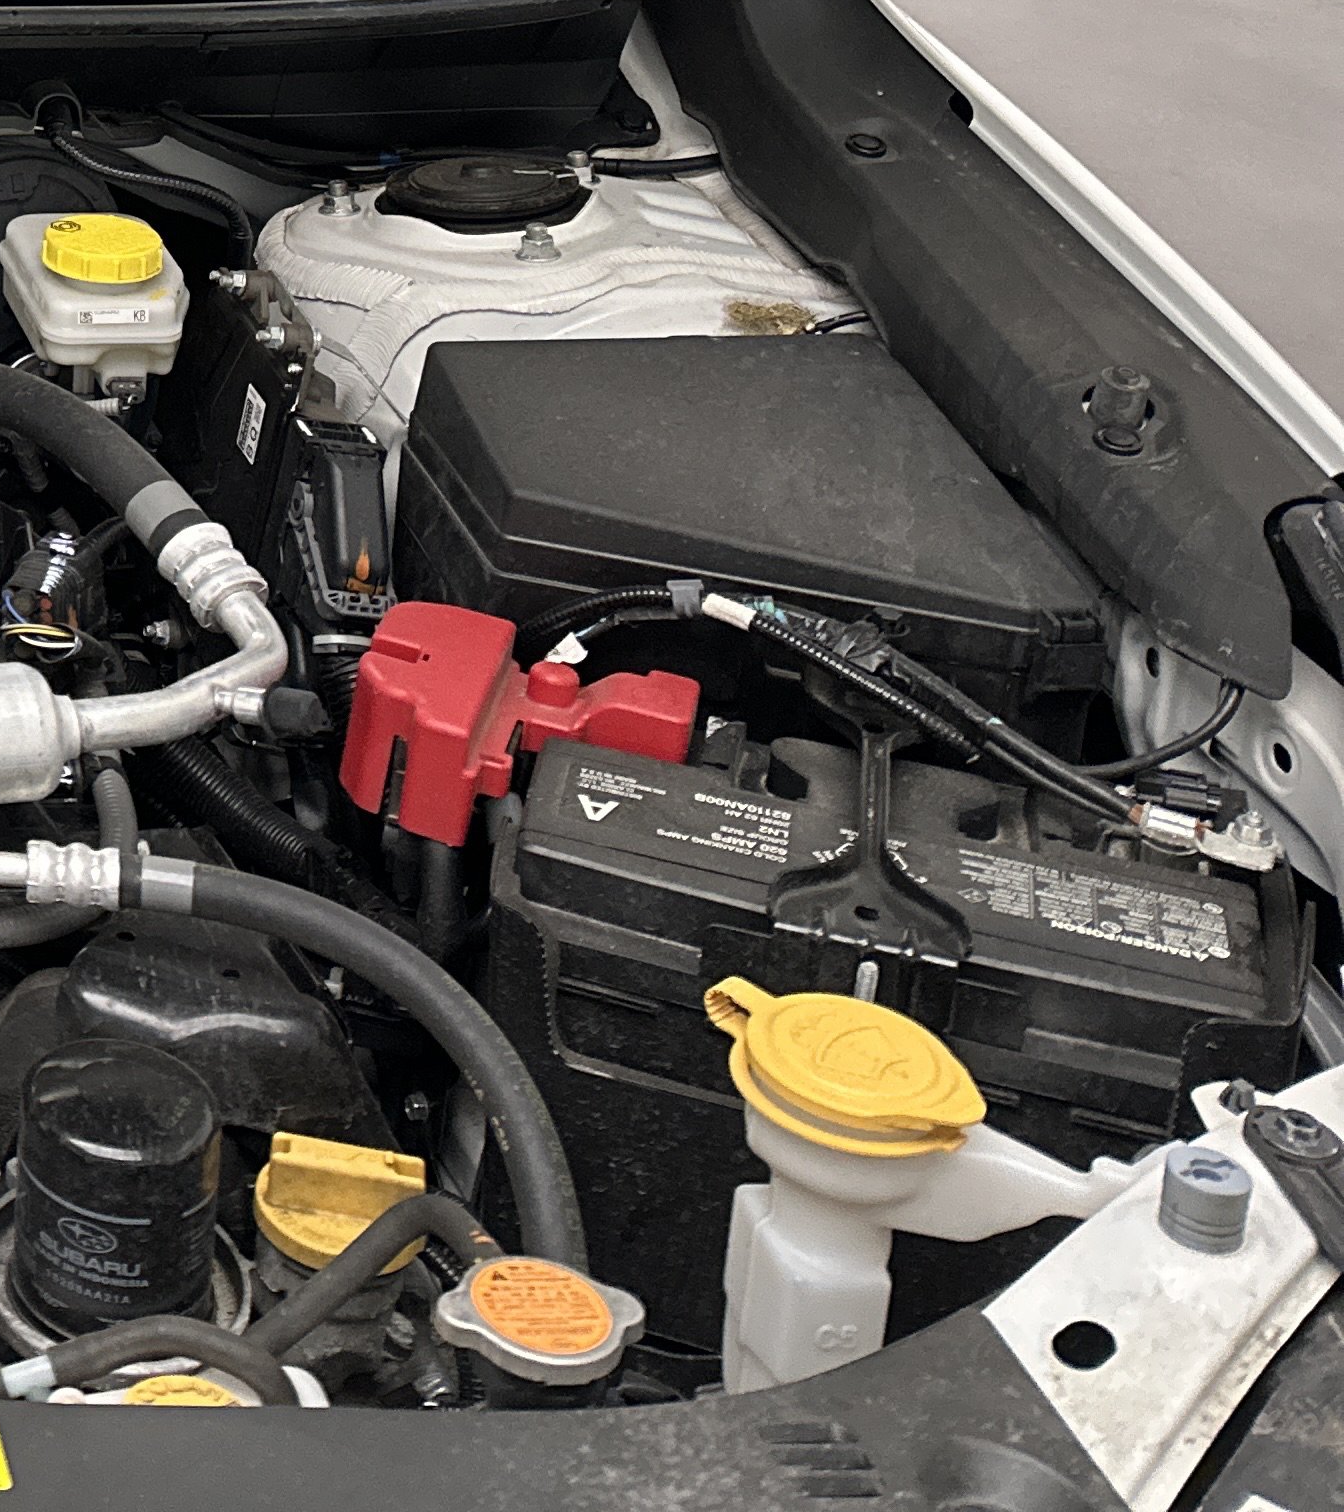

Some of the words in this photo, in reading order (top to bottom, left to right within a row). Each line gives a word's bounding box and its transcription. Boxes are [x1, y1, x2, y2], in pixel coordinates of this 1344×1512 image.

[133, 309, 146, 322] KB
[655, 827, 690, 841] AMPS
[719, 825, 745, 836] SIZE
[758, 825, 789, 838] LN2
[709, 830, 757, 849] AMPS
[746, 831, 789, 846] GROUP
[691, 836, 753, 856] CRANKING
[759, 843, 788, 856] 620
[753, 851, 787, 864] COLD
[38, 1230, 141, 1277] SUBARU
